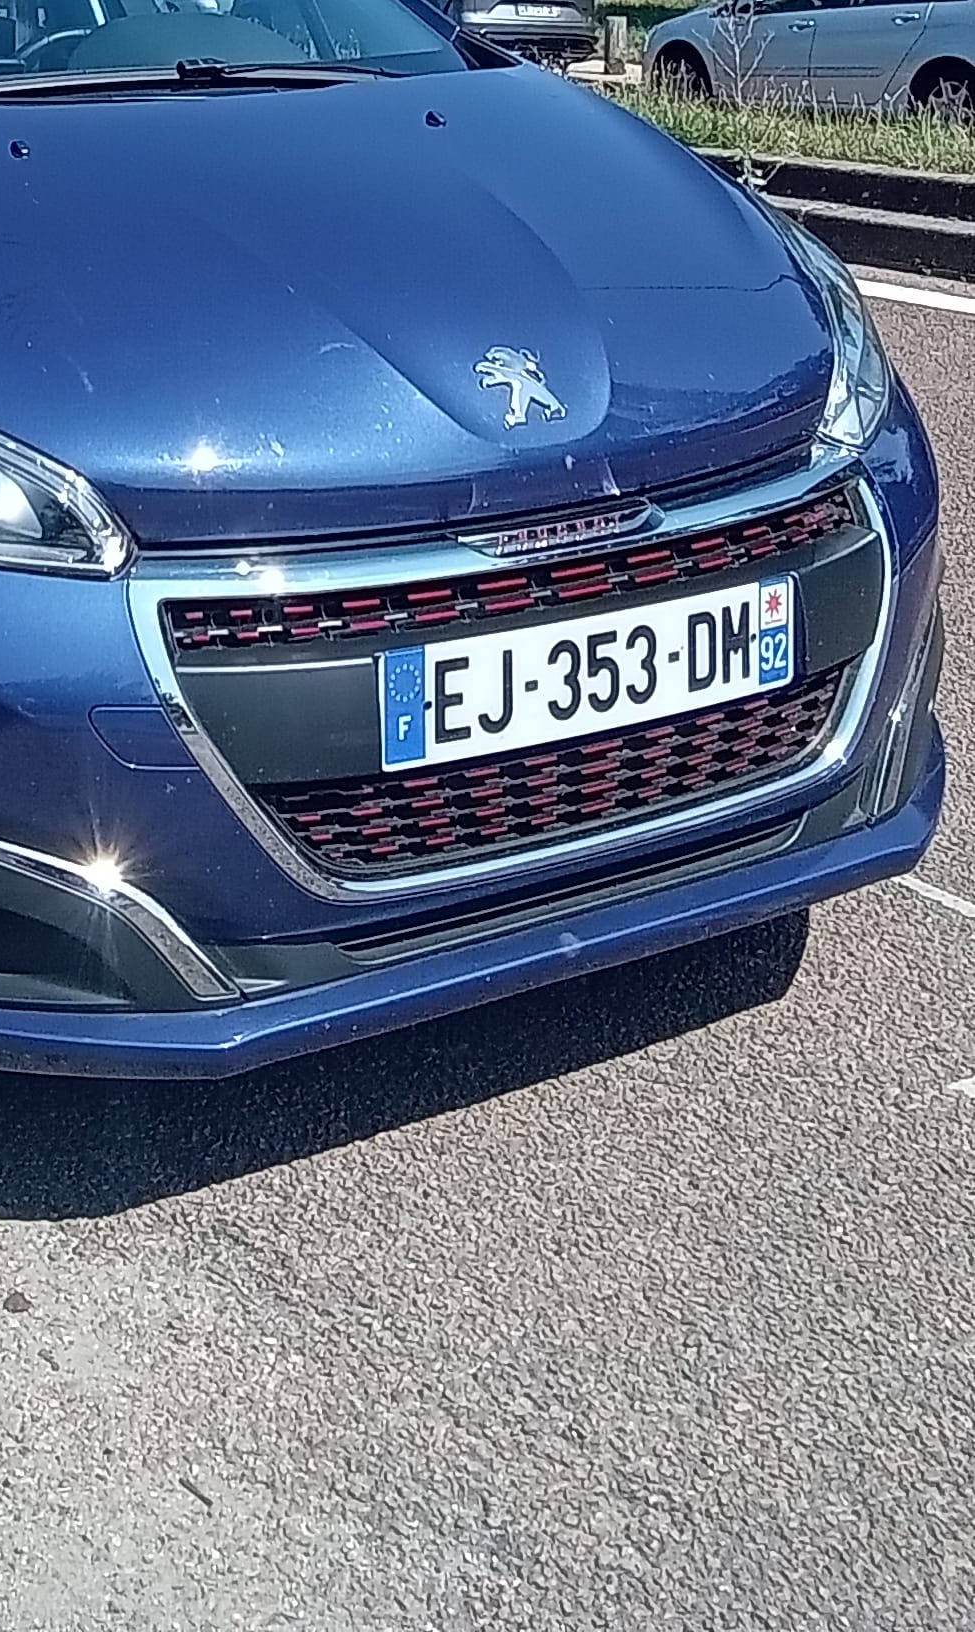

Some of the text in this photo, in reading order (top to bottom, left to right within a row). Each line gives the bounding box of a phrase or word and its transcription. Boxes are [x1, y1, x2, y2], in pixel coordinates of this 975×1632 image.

[760, 632, 788, 672] 92
[434, 601, 751, 744] EJ-353-DM
[396, 713, 412, 742] F
